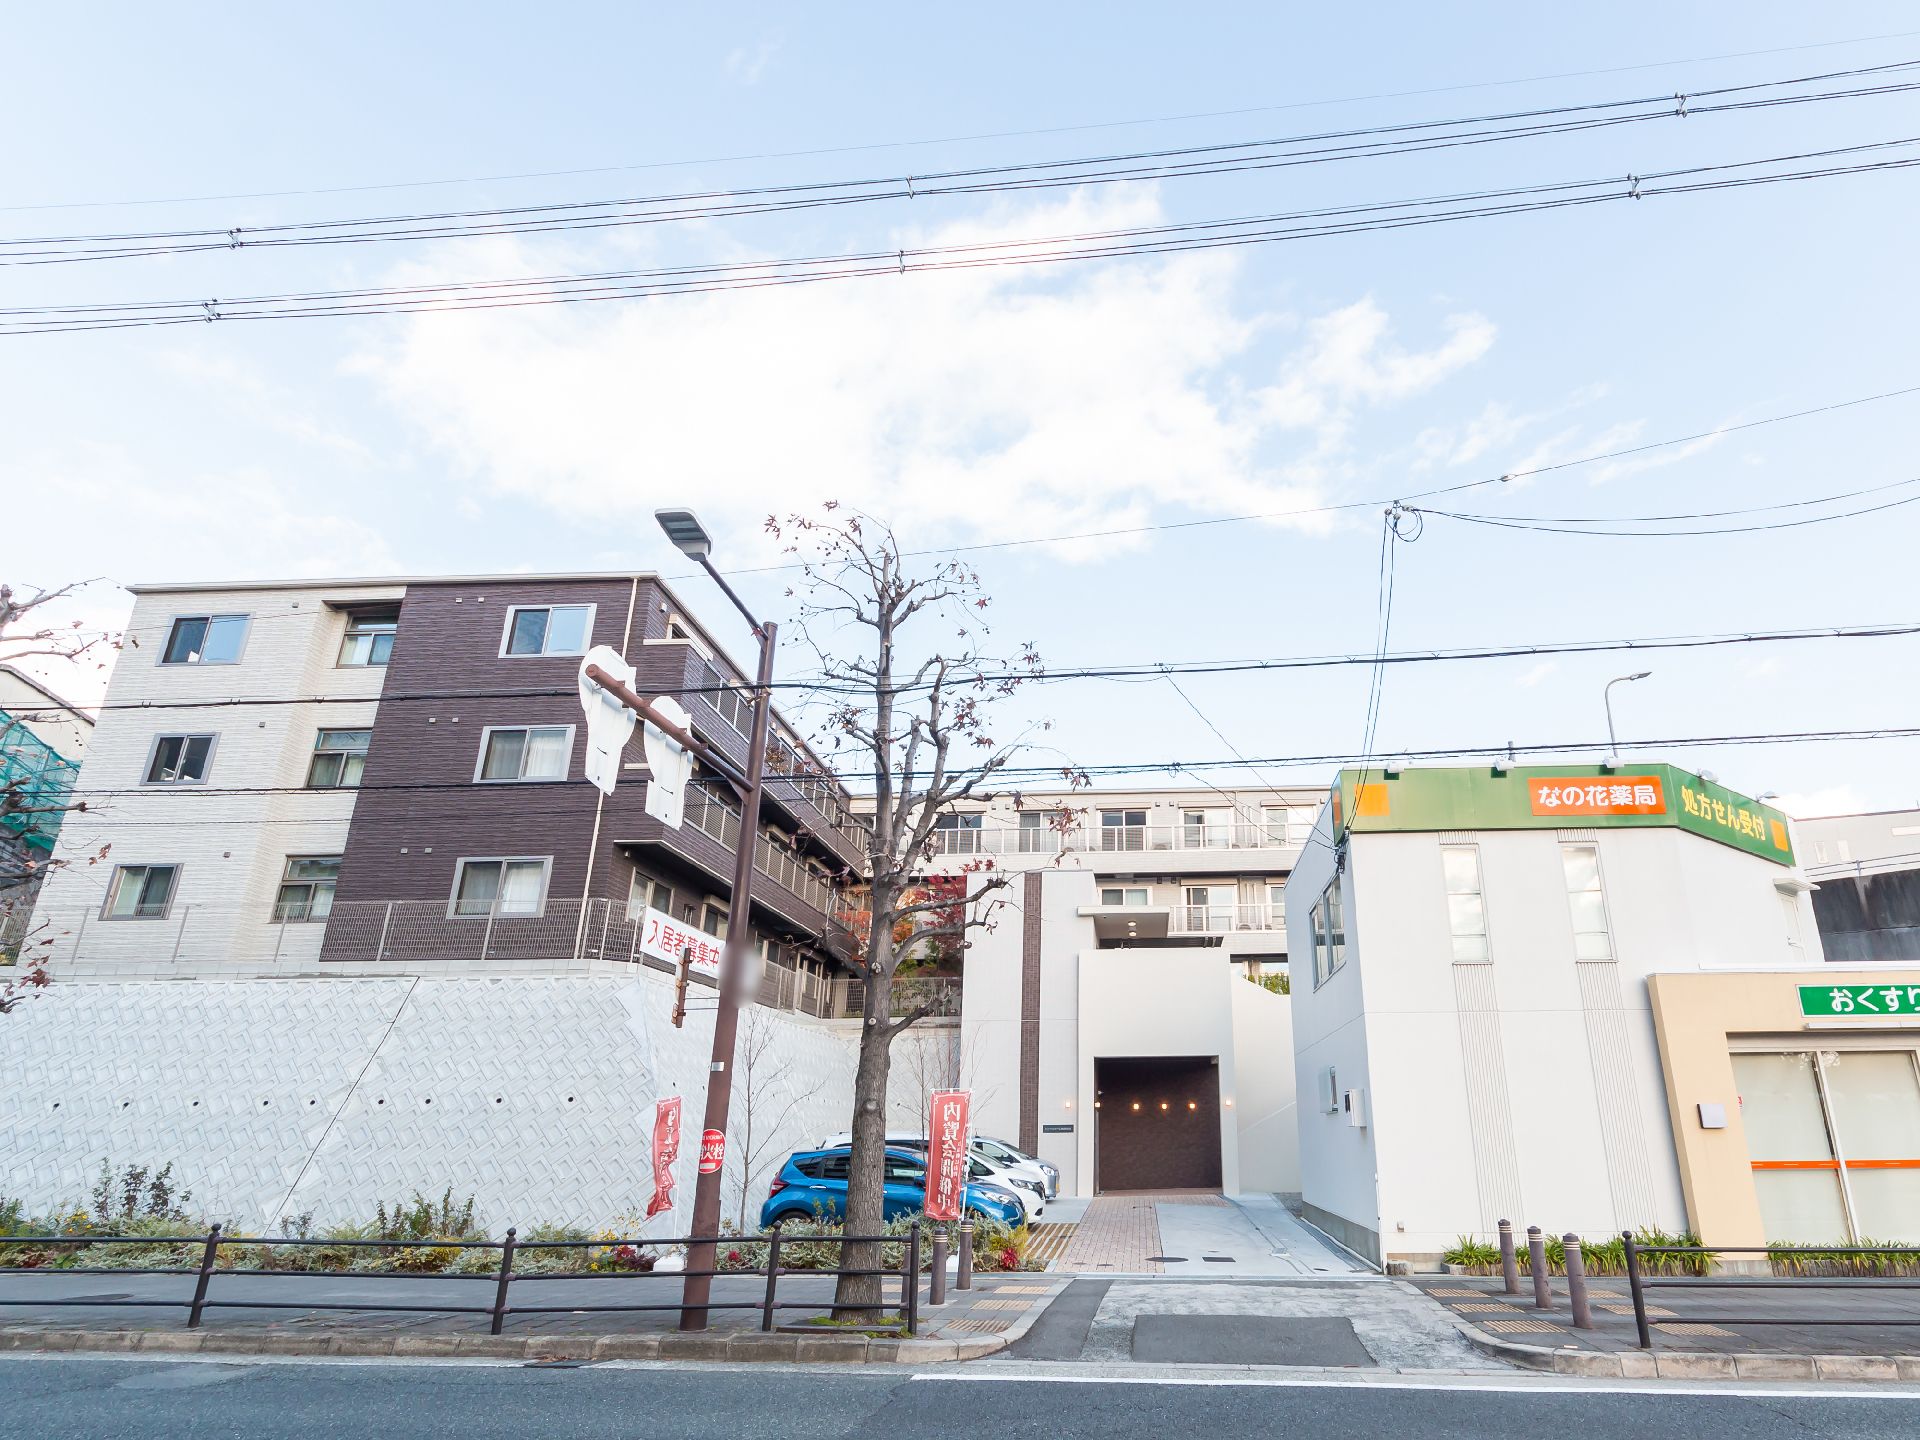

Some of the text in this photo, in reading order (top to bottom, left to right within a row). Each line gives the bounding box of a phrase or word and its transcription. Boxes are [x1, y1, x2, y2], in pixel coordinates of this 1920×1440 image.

[1538, 785, 1656, 807] なの花薬局
[1682, 785, 1765, 840] 処方せん受付
[647, 919, 720, 968] 入居者募集中
